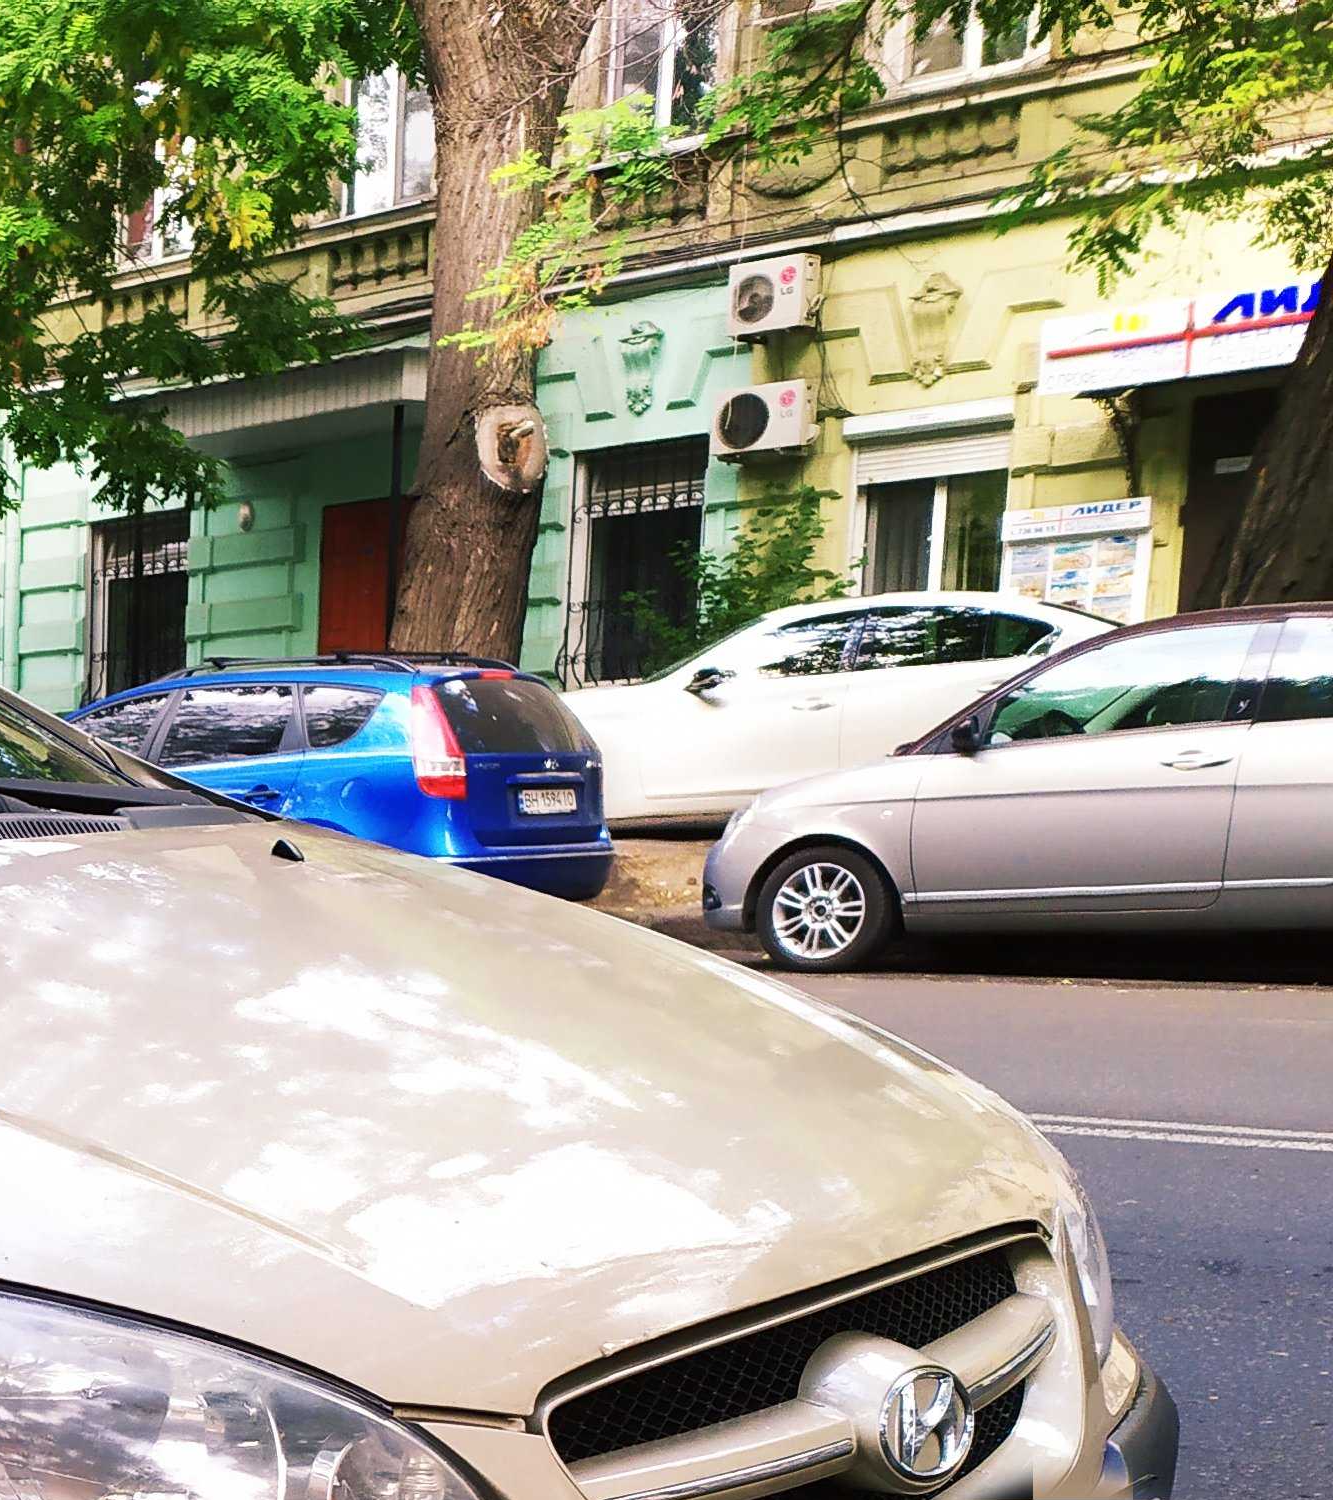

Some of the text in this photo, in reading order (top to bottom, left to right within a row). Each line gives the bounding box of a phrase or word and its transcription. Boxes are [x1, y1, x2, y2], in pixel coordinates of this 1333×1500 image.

[780, 286, 794, 295] LG
[1071, 500, 1141, 516] ЛИДЕР
[524, 791, 539, 808] BH
